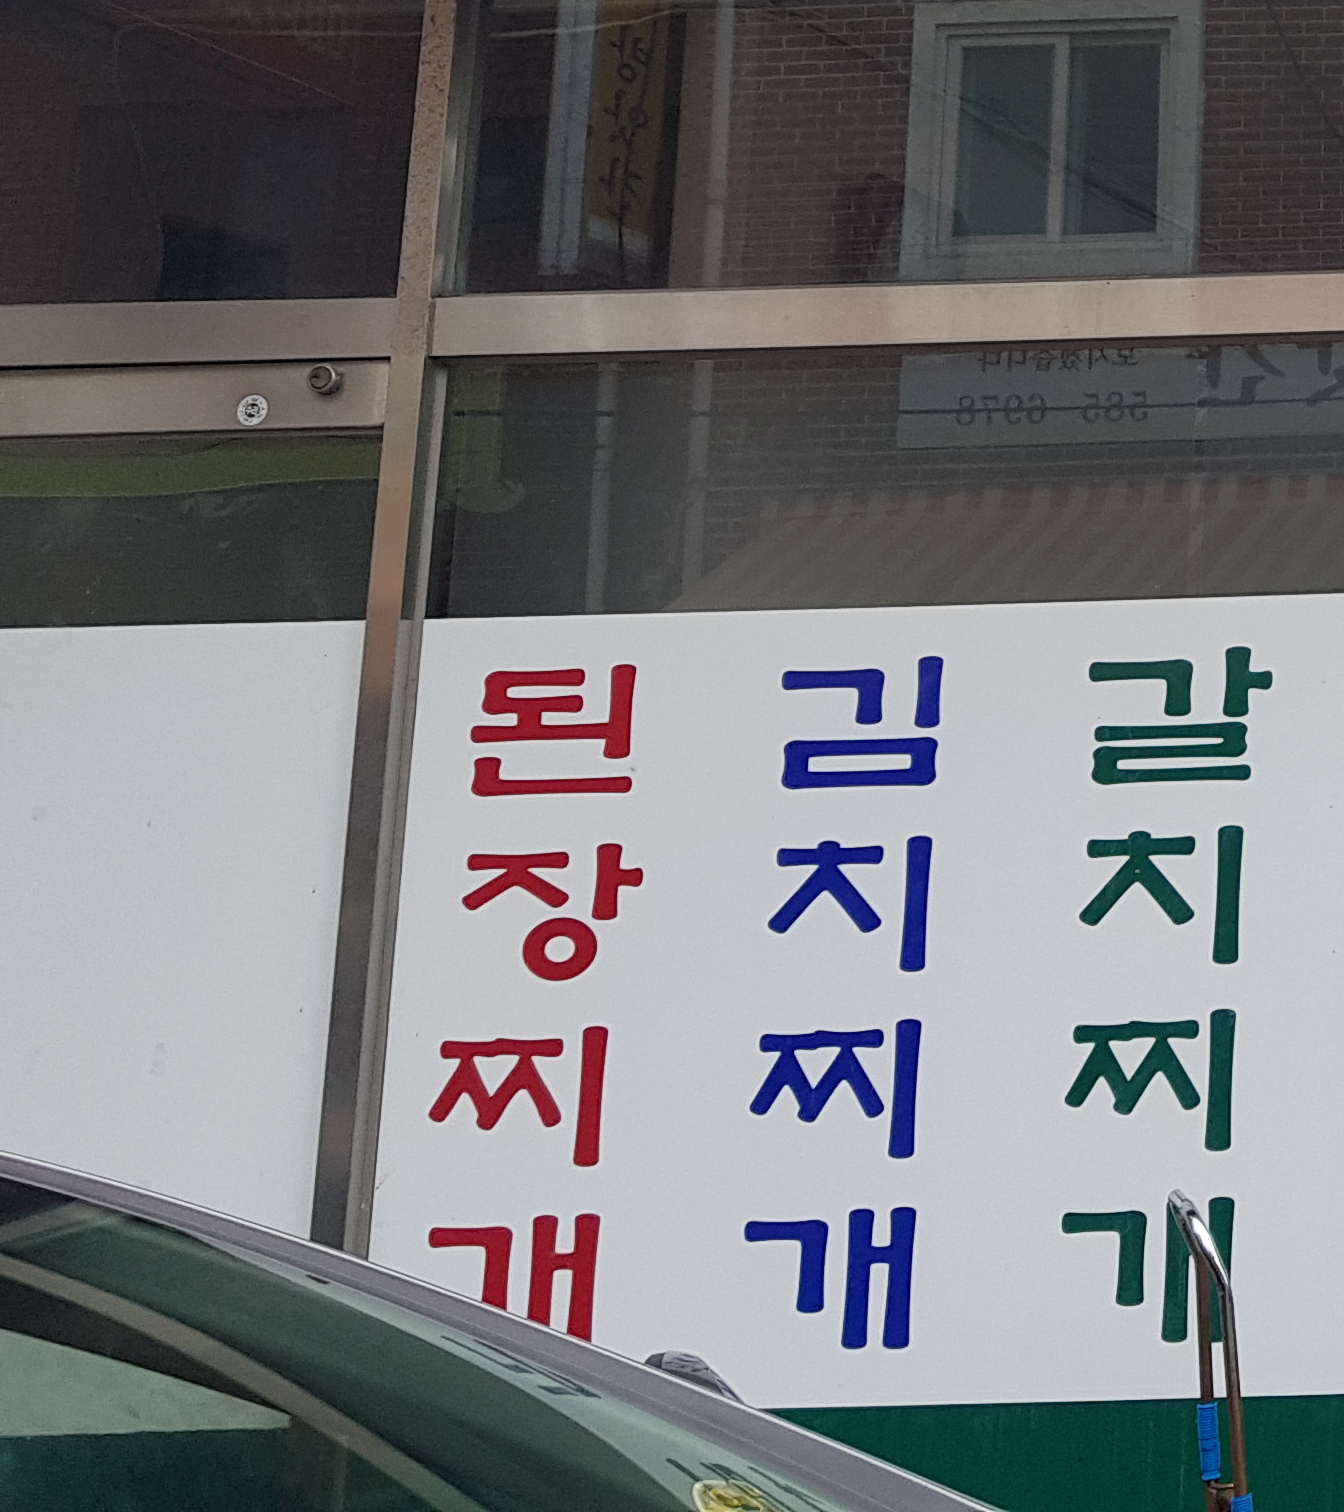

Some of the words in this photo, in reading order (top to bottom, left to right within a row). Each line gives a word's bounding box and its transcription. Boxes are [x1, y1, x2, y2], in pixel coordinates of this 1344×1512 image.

[428, 663, 643, 1345] 된장찌개
[744, 655, 944, 1350] 김치찌개
[1061, 646, 1274, 1344] 갈치찌개
